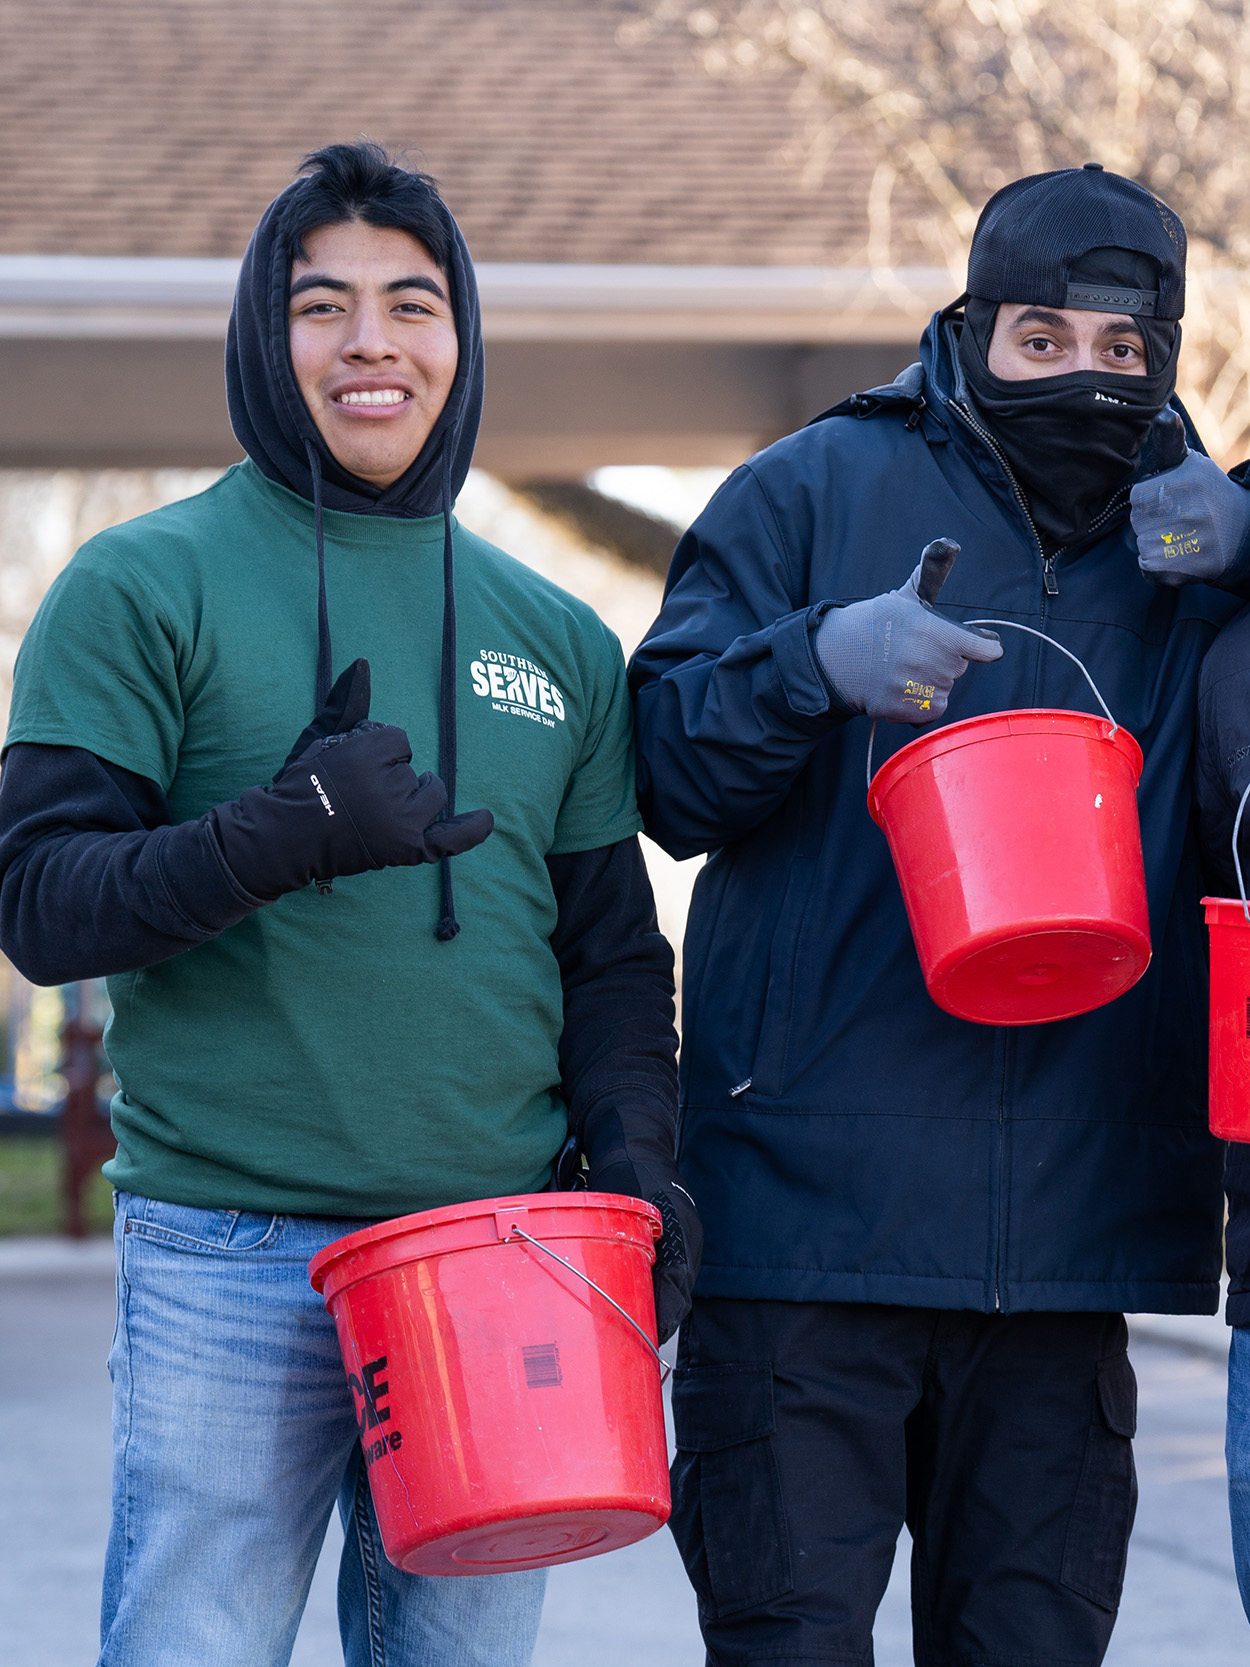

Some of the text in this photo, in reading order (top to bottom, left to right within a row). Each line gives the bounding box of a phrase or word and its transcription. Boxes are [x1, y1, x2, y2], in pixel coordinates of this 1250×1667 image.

[480, 649, 549, 680] SOUTHERN
[470, 660, 565, 721] SERVES
[492, 702, 556, 728] MLK SERVICE DAY
[310, 774, 335, 816] HEAD
